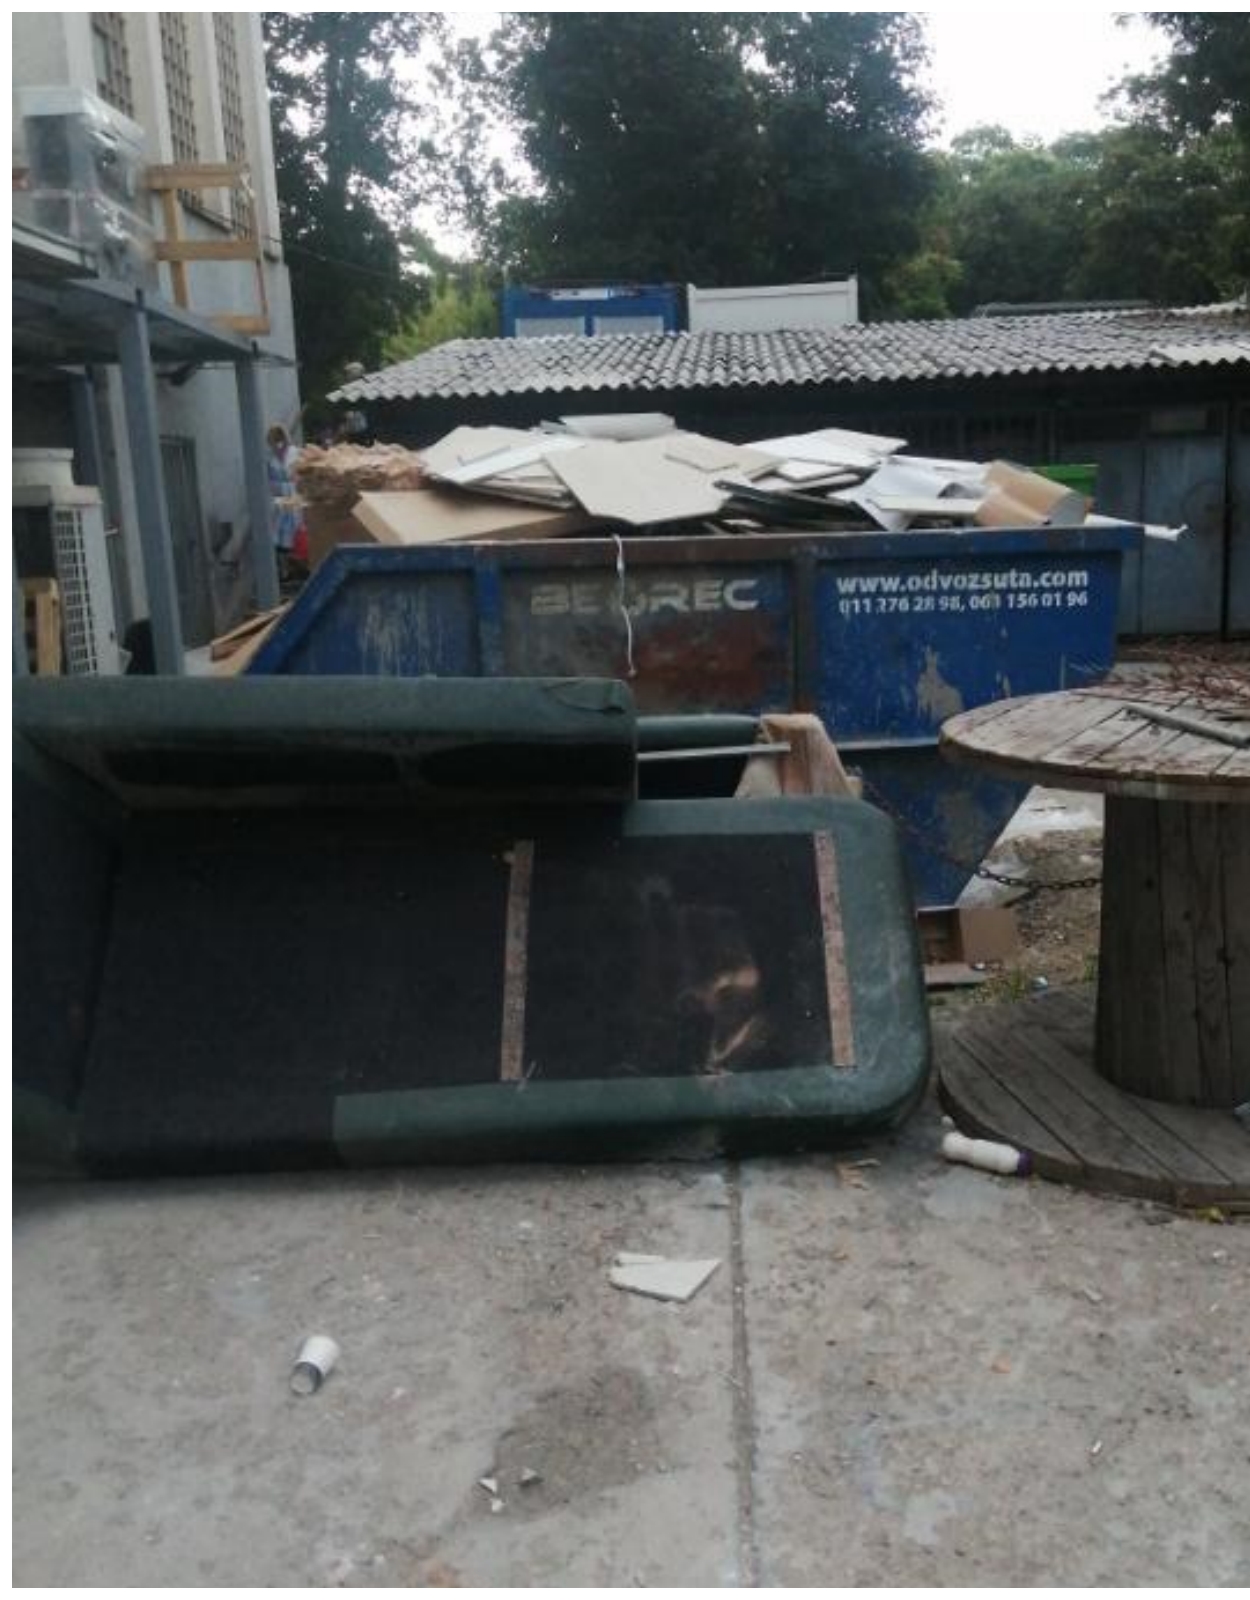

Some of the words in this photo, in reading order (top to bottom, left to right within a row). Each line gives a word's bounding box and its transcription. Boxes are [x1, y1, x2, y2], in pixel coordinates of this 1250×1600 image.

[836, 569, 1088, 593] www.odvozsuta.com
[1006, 593, 1038, 608] 156
[1042, 592, 1062, 606] 01
[1067, 592, 1088, 606] 96
